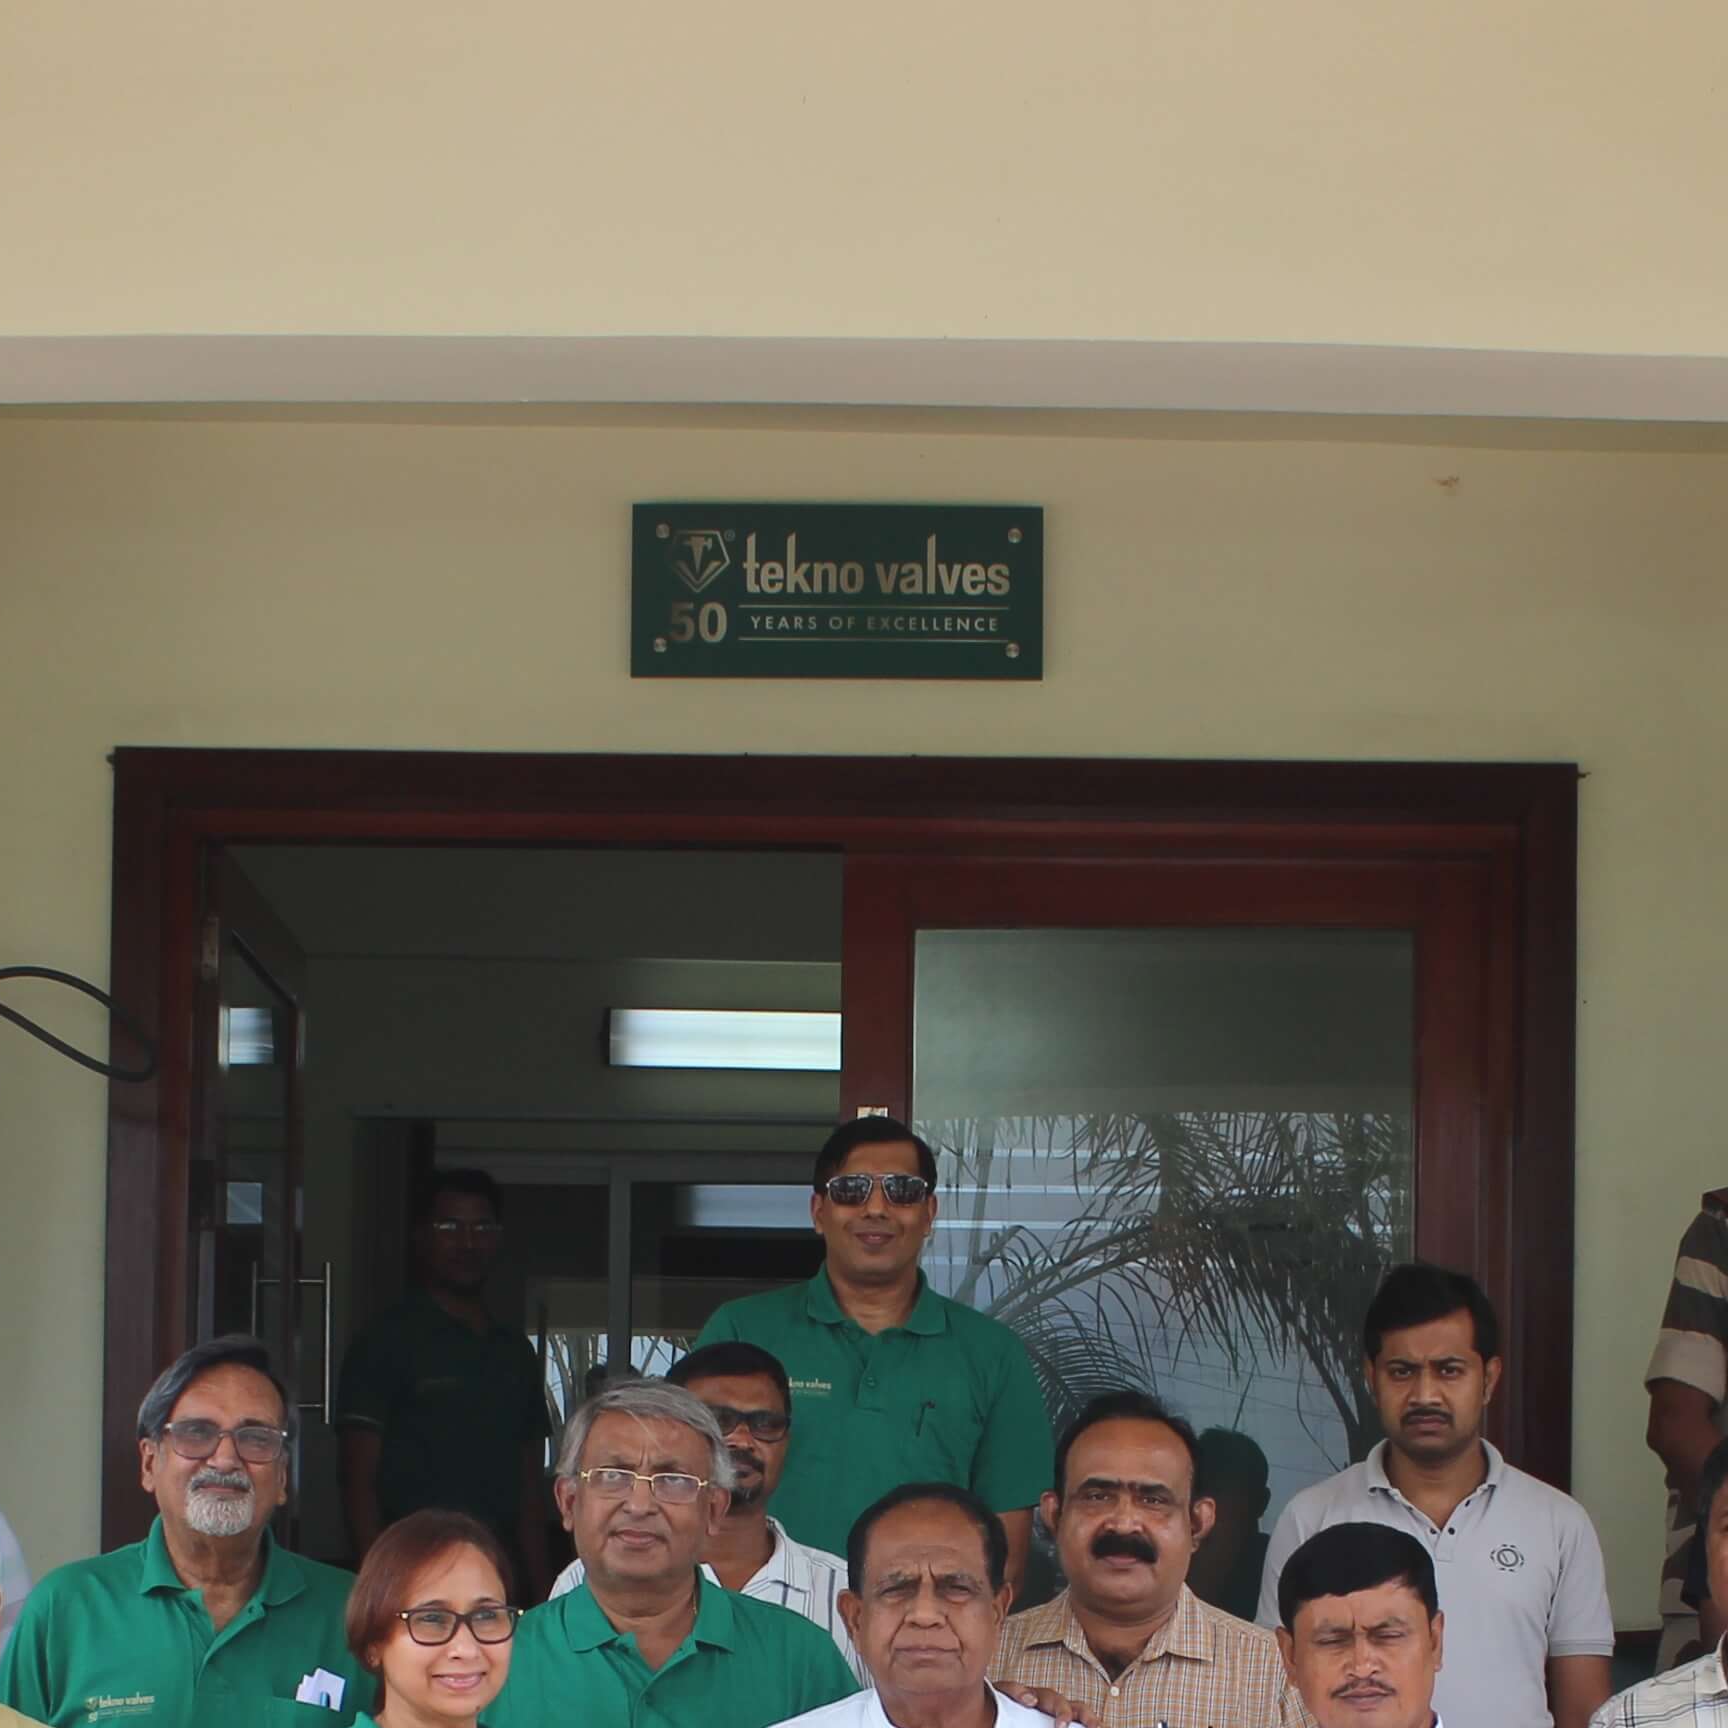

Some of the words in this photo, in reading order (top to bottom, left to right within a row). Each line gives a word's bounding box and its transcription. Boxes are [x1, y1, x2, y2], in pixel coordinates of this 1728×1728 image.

[743, 531, 864, 594] tekno
[875, 533, 1010, 596] valves
[670, 602, 728, 644] 50
[751, 614, 818, 631] YEARS
[829, 615, 857, 632] OF
[867, 615, 999, 633] EXCELLENCE
